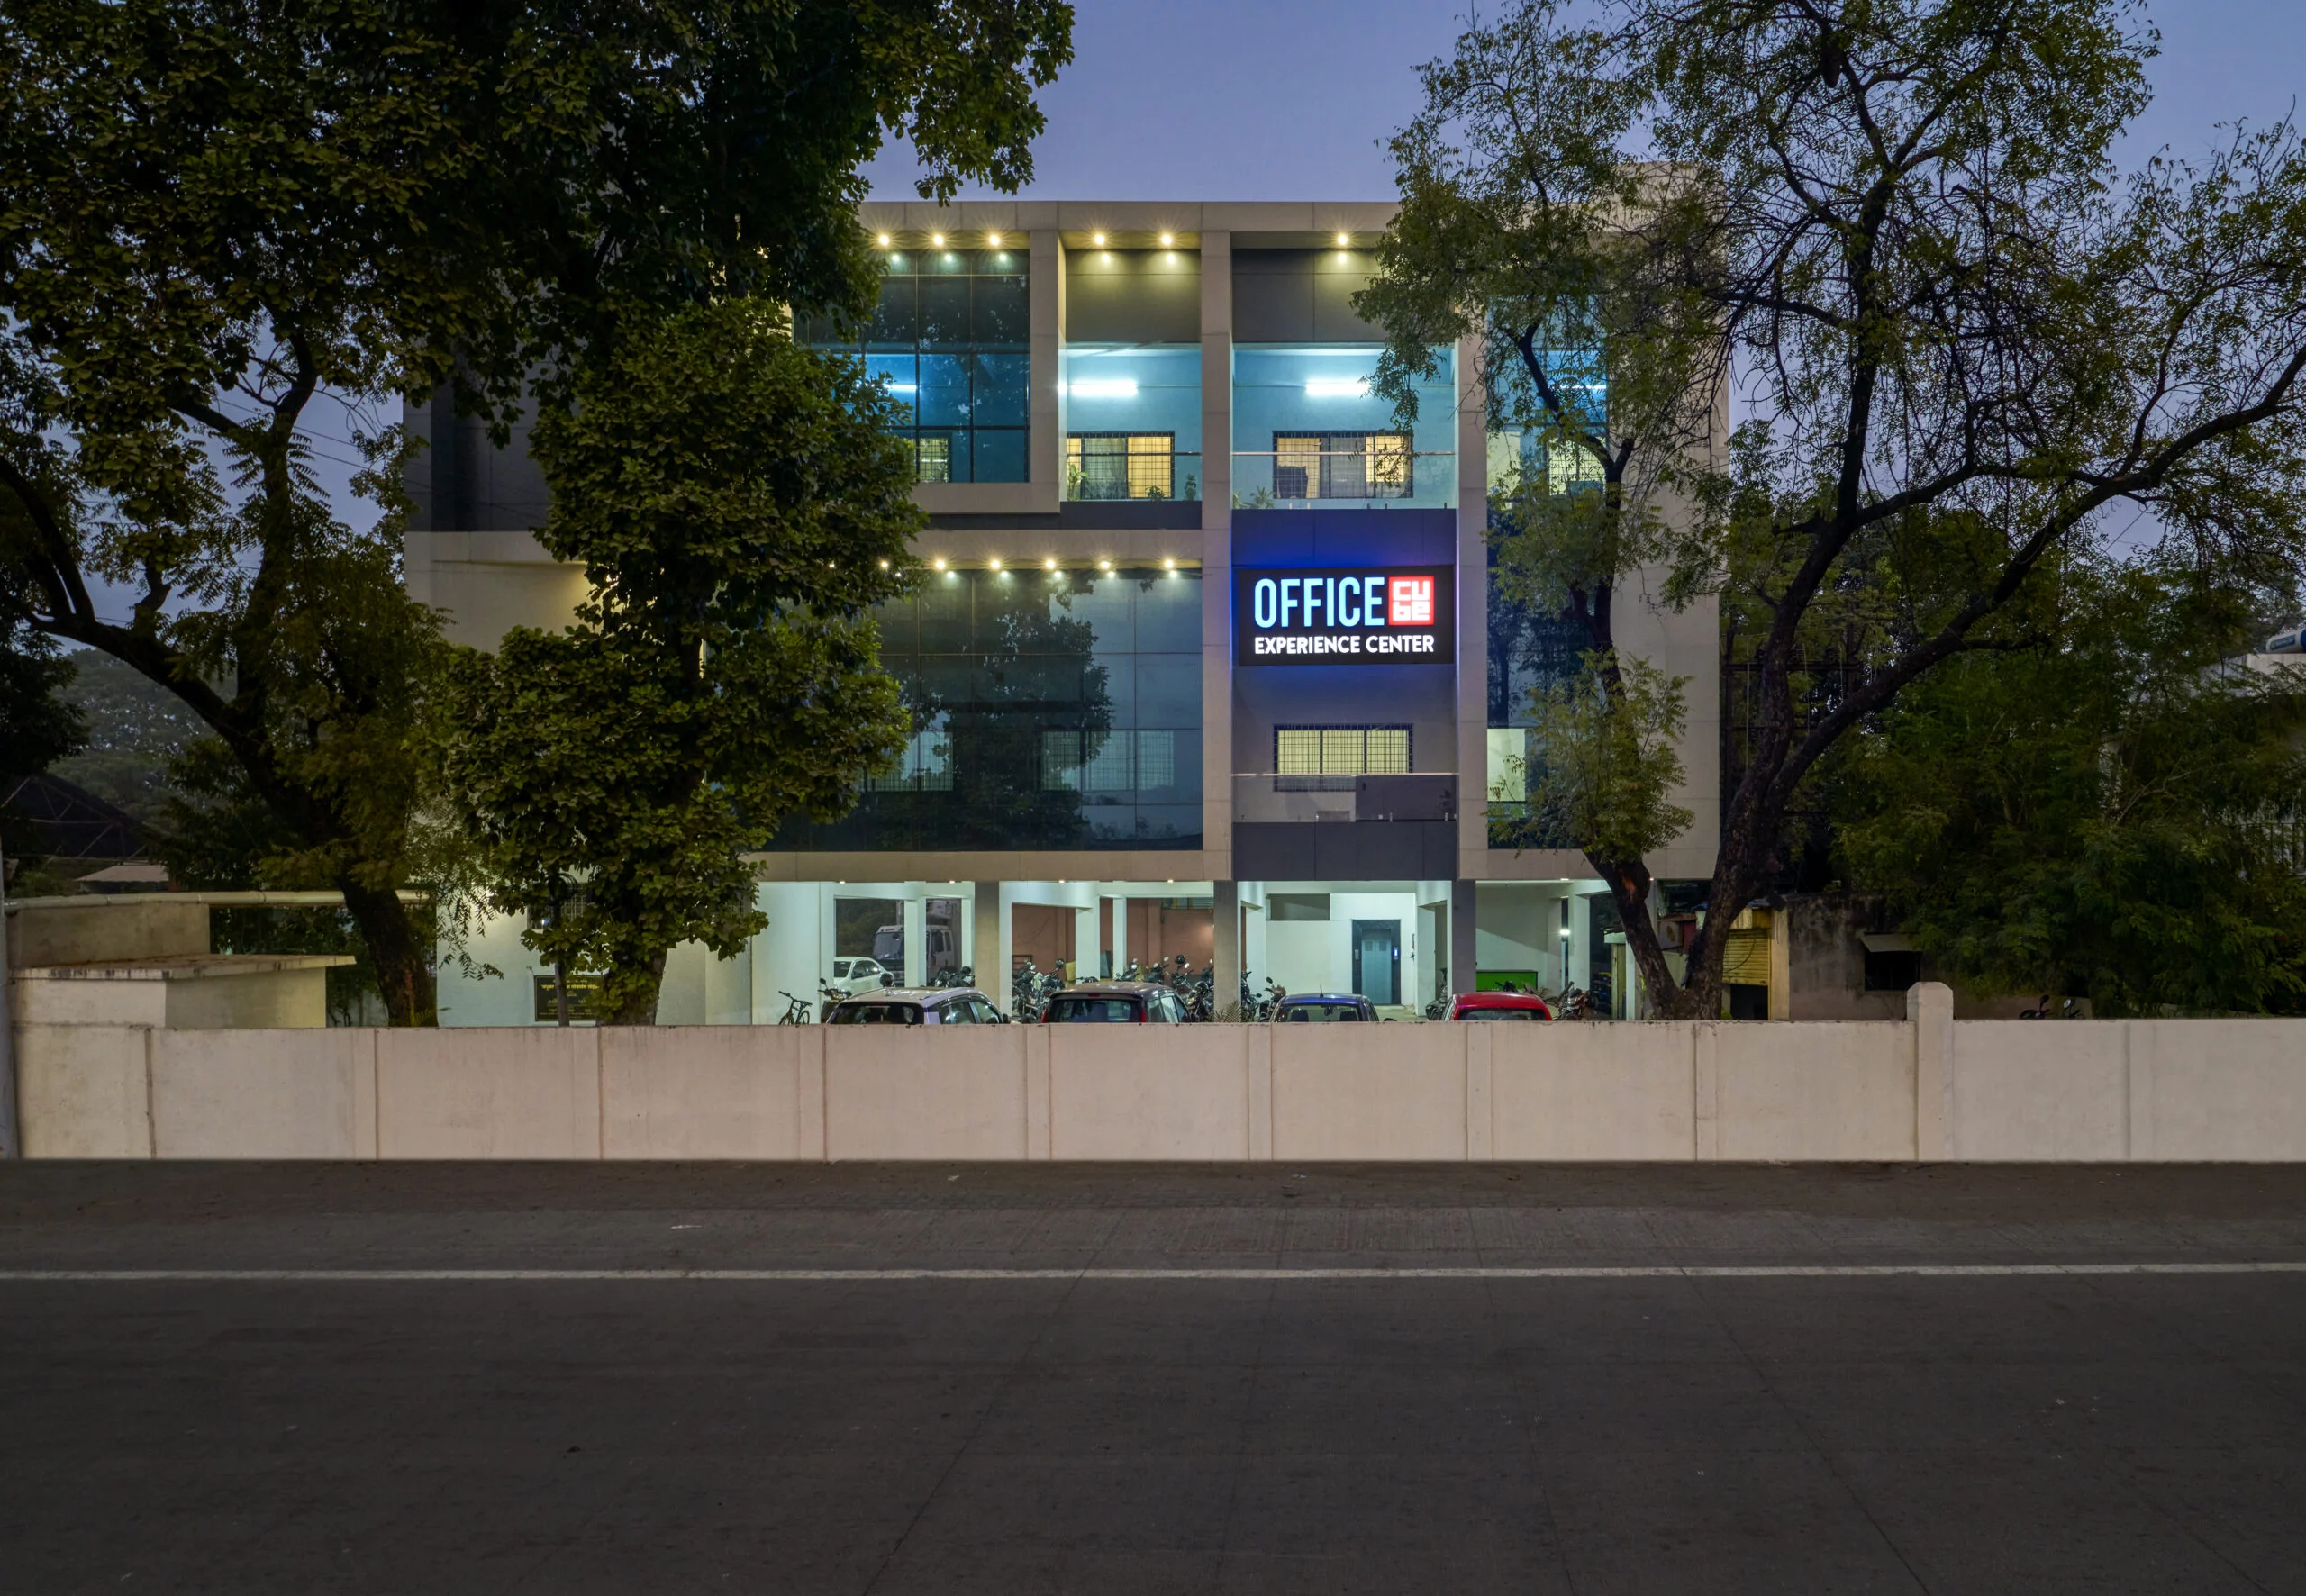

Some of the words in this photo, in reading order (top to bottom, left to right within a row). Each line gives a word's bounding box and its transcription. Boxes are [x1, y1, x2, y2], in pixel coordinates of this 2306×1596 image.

[1255, 577, 1385, 628] OFFICE
[1255, 636, 1360, 654] EXPERIENCE
[1366, 635, 1434, 653] CENTER
